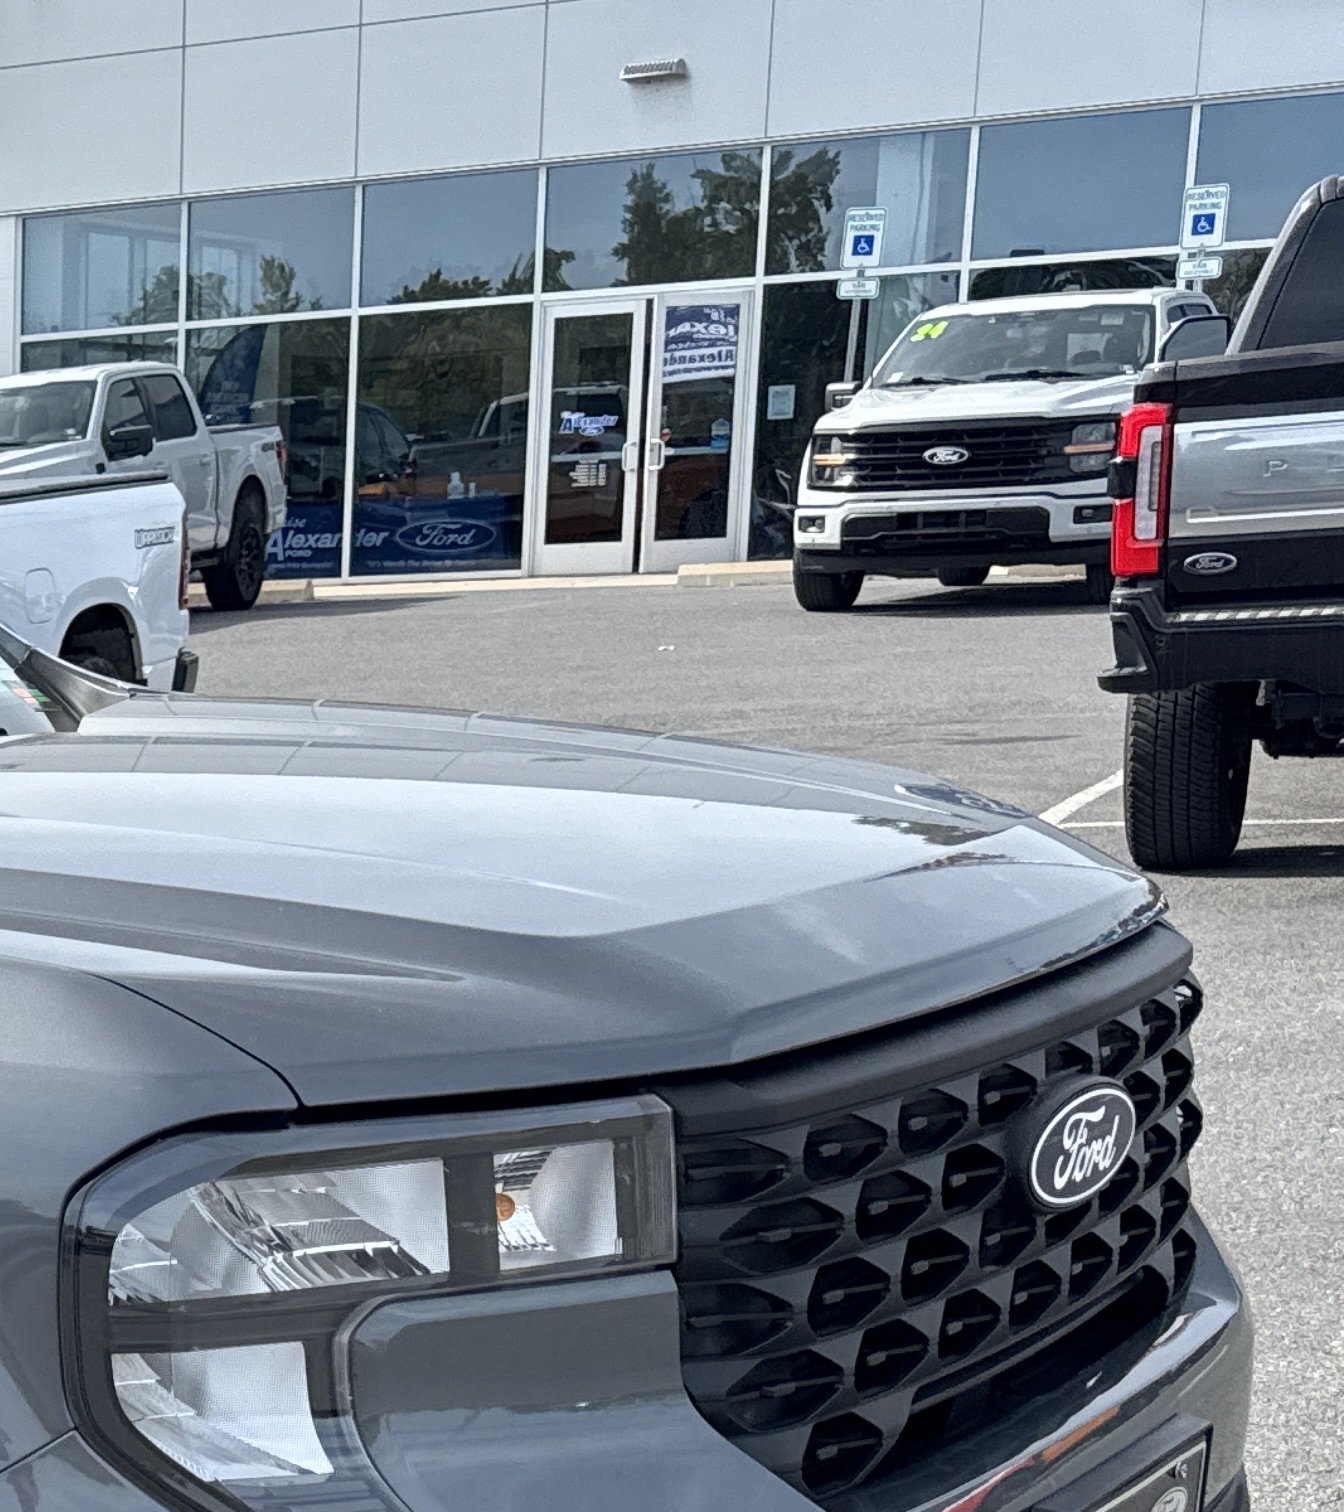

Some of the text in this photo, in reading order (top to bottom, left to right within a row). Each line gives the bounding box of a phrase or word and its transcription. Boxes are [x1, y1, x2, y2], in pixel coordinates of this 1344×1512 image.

[1189, 202, 1222, 212] PARKING
[415, 522, 474, 546] Ford
[1054, 1105, 1120, 1190] Ford
